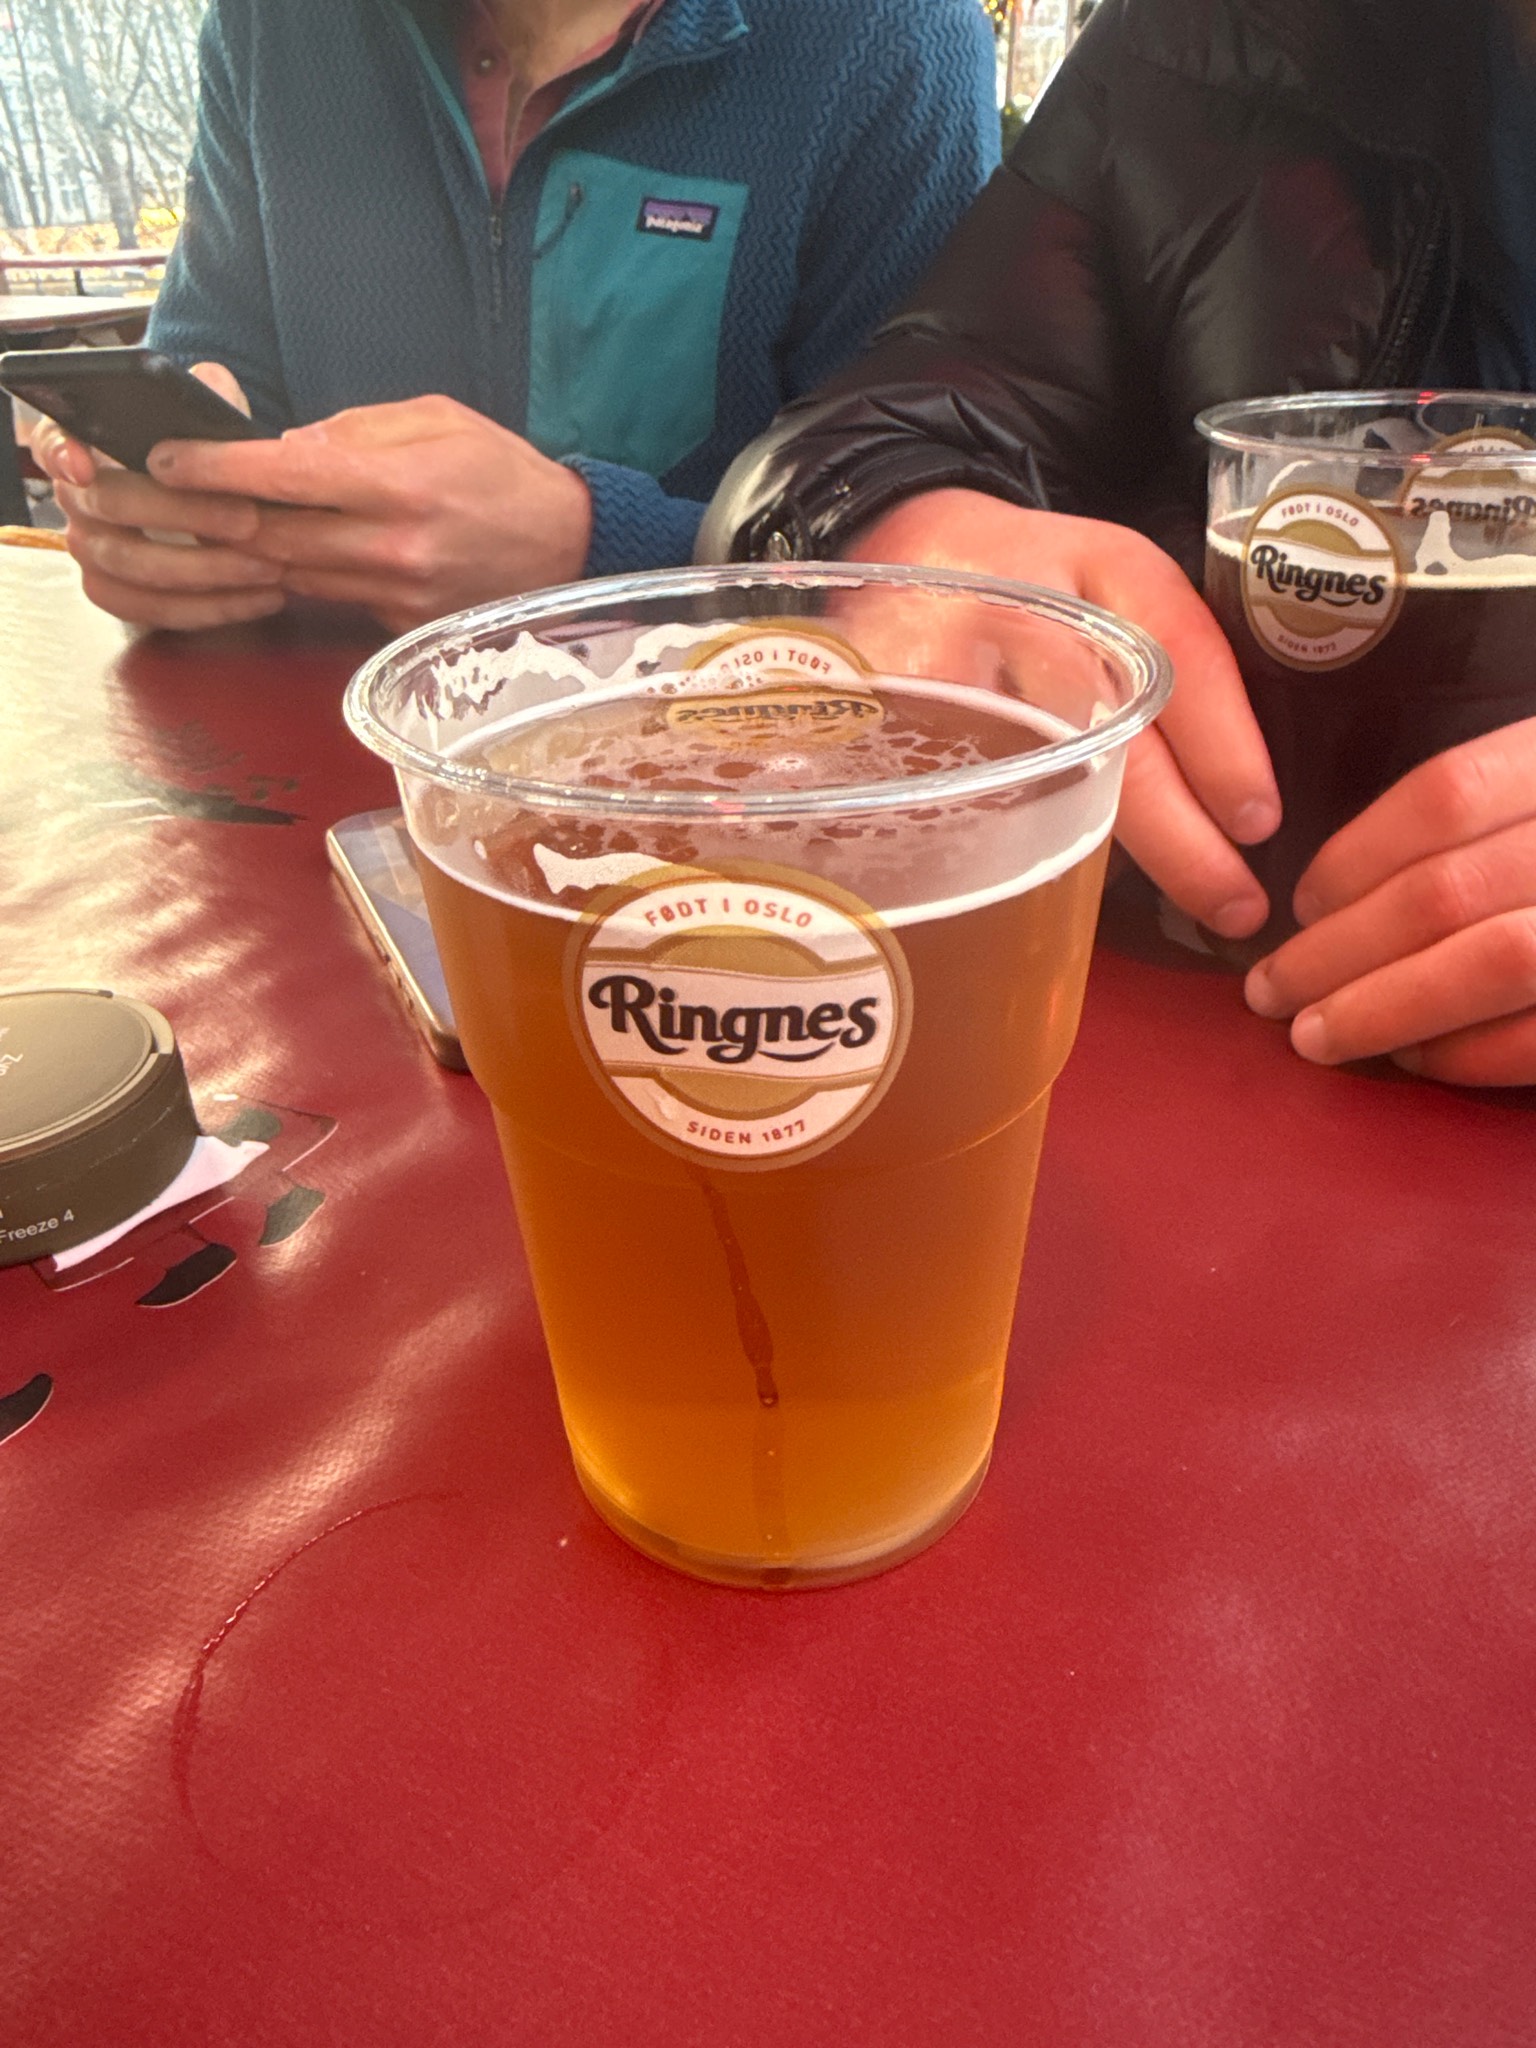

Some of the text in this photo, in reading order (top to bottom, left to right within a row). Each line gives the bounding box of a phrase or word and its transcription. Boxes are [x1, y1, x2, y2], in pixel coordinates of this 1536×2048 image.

[1316, 502, 1321, 514] I
[1325, 505, 1359, 527] OSLO
[1250, 544, 1387, 607] Ringnes
[644, 896, 814, 928] FØDT I OSLO
[587, 974, 878, 1064] Ringnes
[686, 1118, 806, 1145] SIDEN 1877
[63, 1208, 75, 1222] 4
